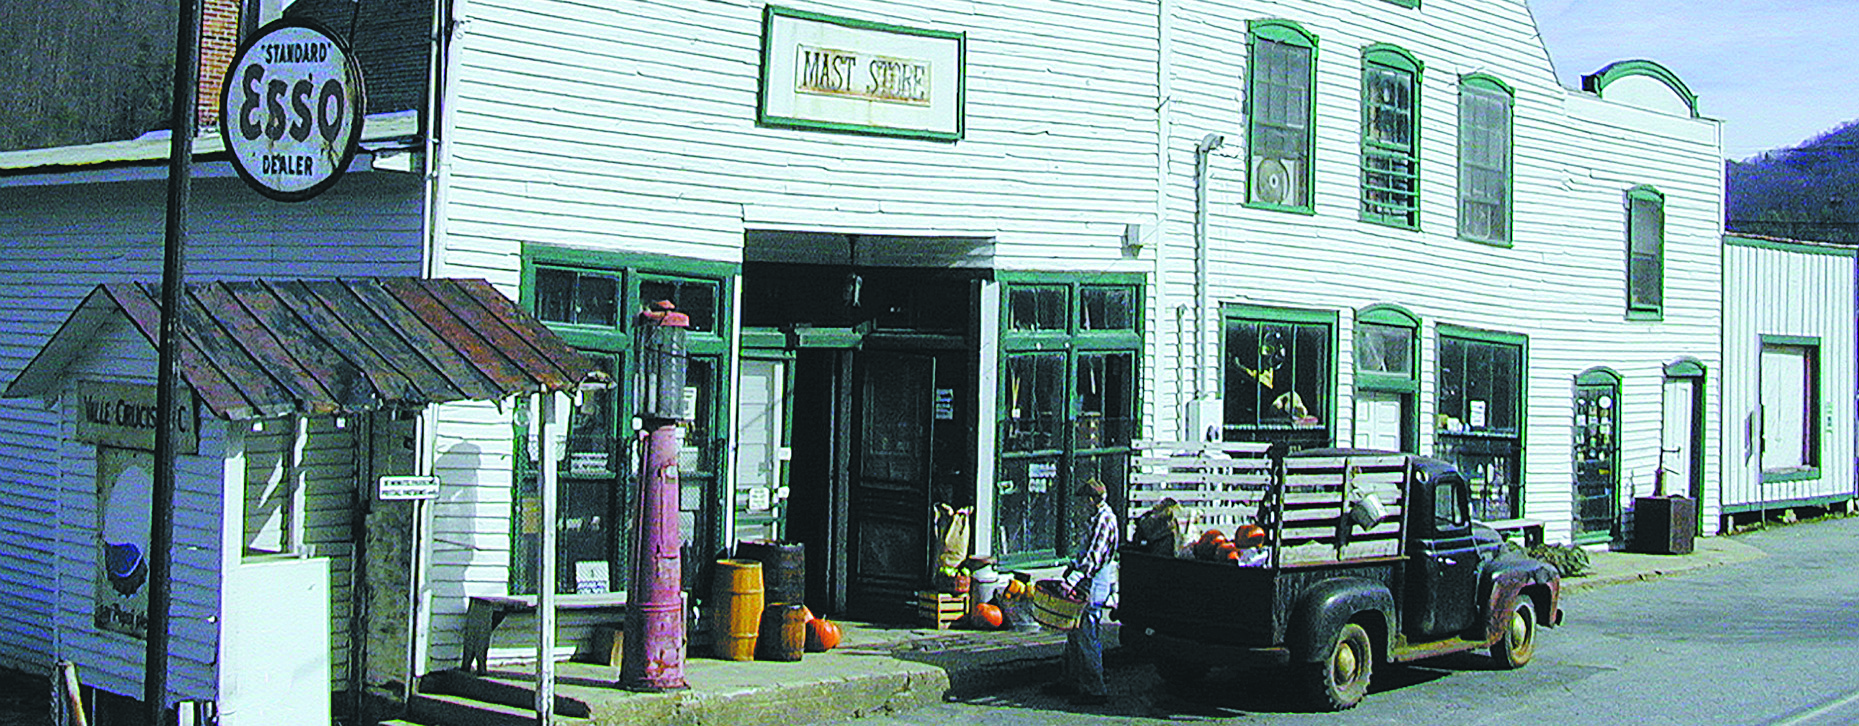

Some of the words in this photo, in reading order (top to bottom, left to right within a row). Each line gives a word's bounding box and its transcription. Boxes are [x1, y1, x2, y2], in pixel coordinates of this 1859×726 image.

[802, 51, 856, 91] MAST
[866, 60, 925, 100] STORE
[262, 153, 314, 176] DEALER
